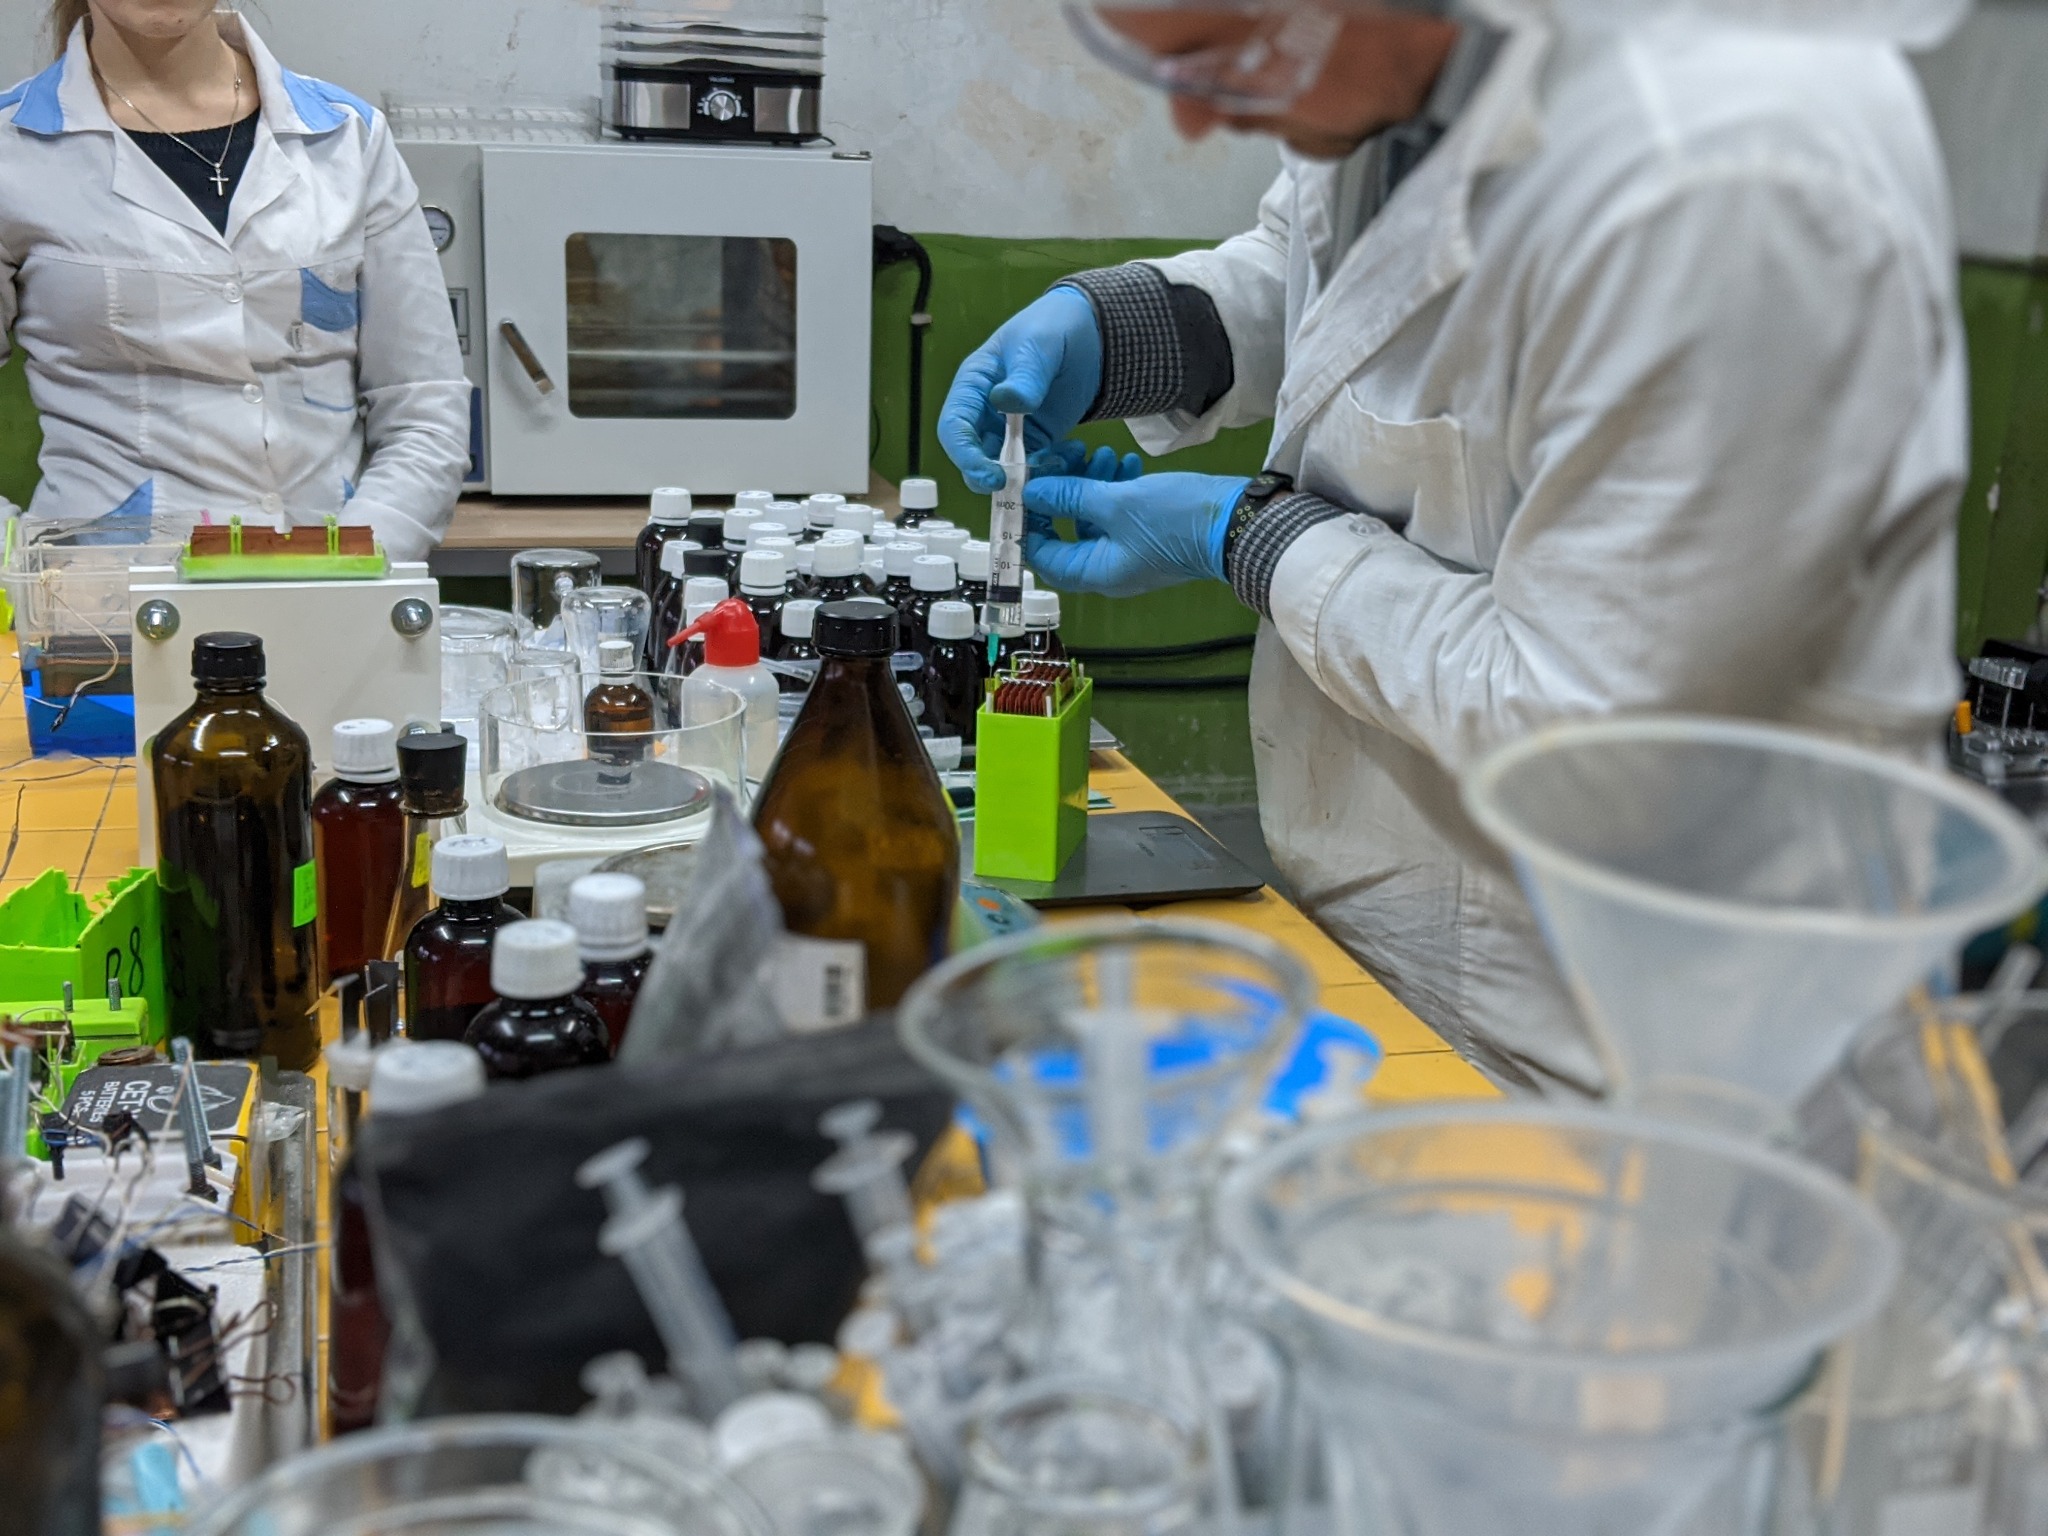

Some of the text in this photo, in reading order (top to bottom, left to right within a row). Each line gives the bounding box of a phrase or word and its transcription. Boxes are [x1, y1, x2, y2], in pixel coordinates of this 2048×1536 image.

[1002, 531, 1013, 540] 15
[1000, 561, 1011, 570] 10
[89, 1081, 121, 1123] BATTERIES
